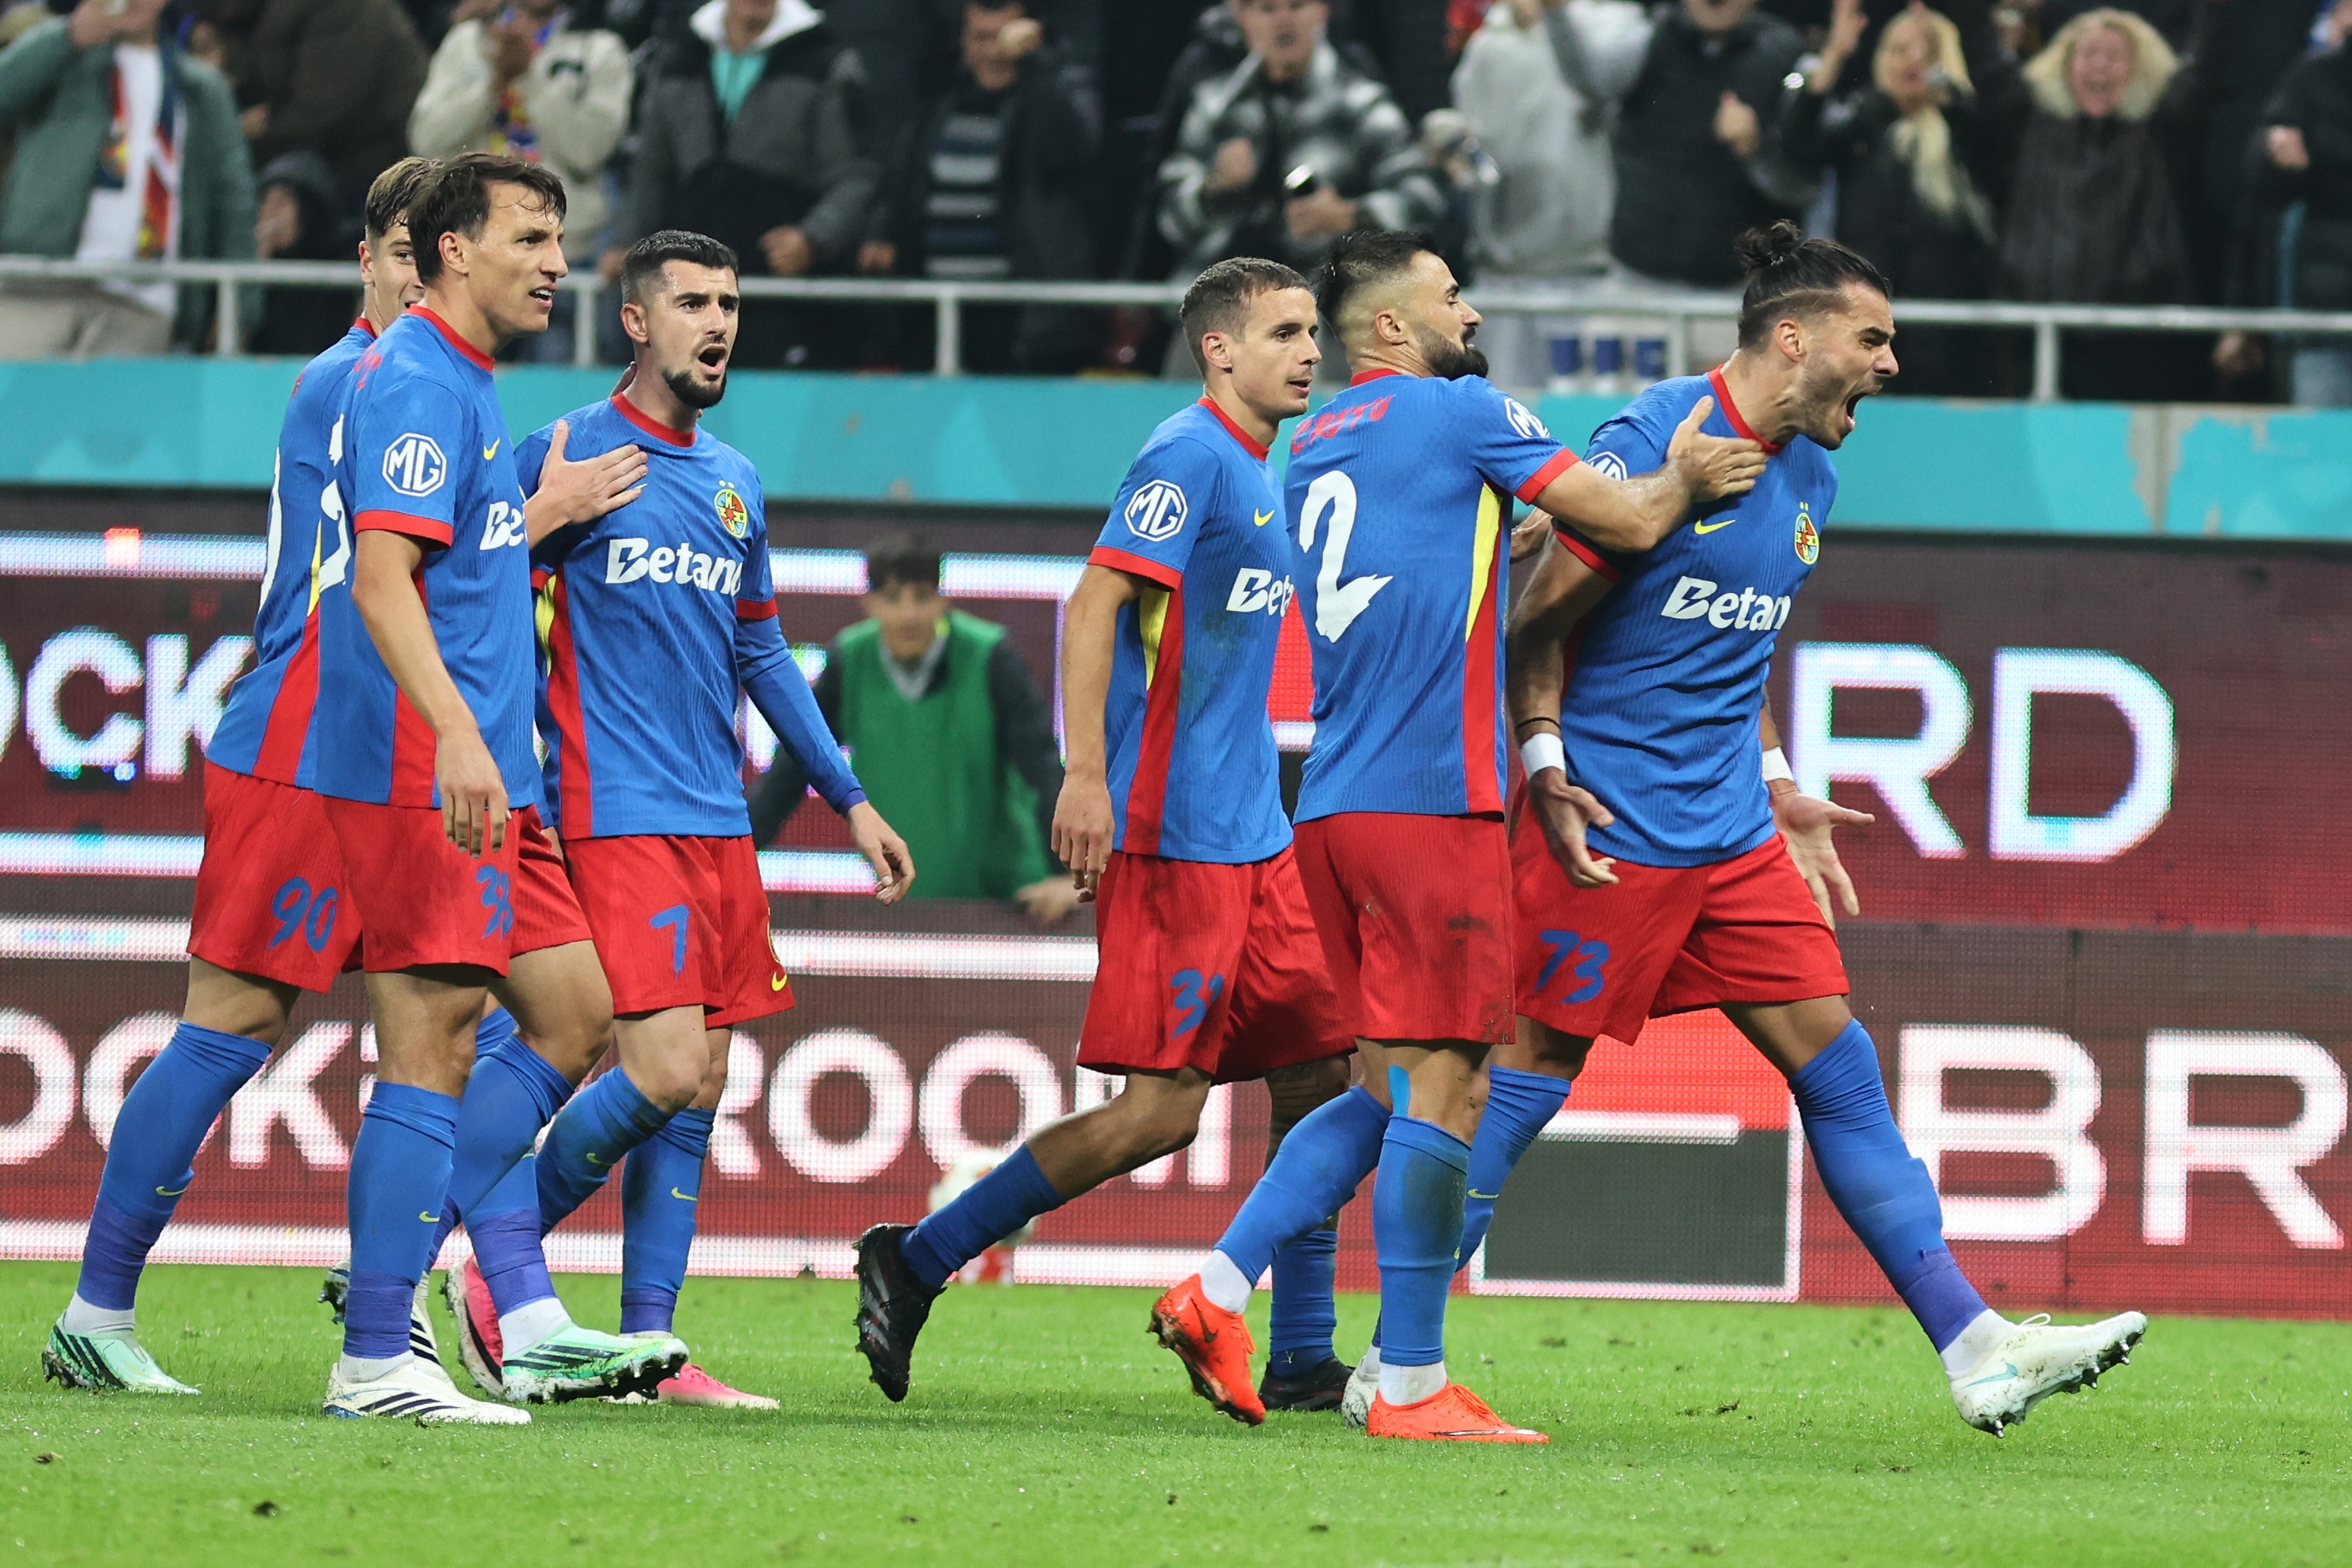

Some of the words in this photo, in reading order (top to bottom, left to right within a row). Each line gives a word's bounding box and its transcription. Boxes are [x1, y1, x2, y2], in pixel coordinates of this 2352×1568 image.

[388, 439, 441, 491] MG
[479, 501, 528, 550] Be
[1130, 485, 1182, 536] MG
[1299, 470, 1393, 643] 2
[0, 625, 256, 782] CK
[266, 876, 337, 952] 90
[650, 903, 690, 980] 7
[1533, 929, 1611, 1004] 73
[1897, 1023, 2349, 1249] BR
